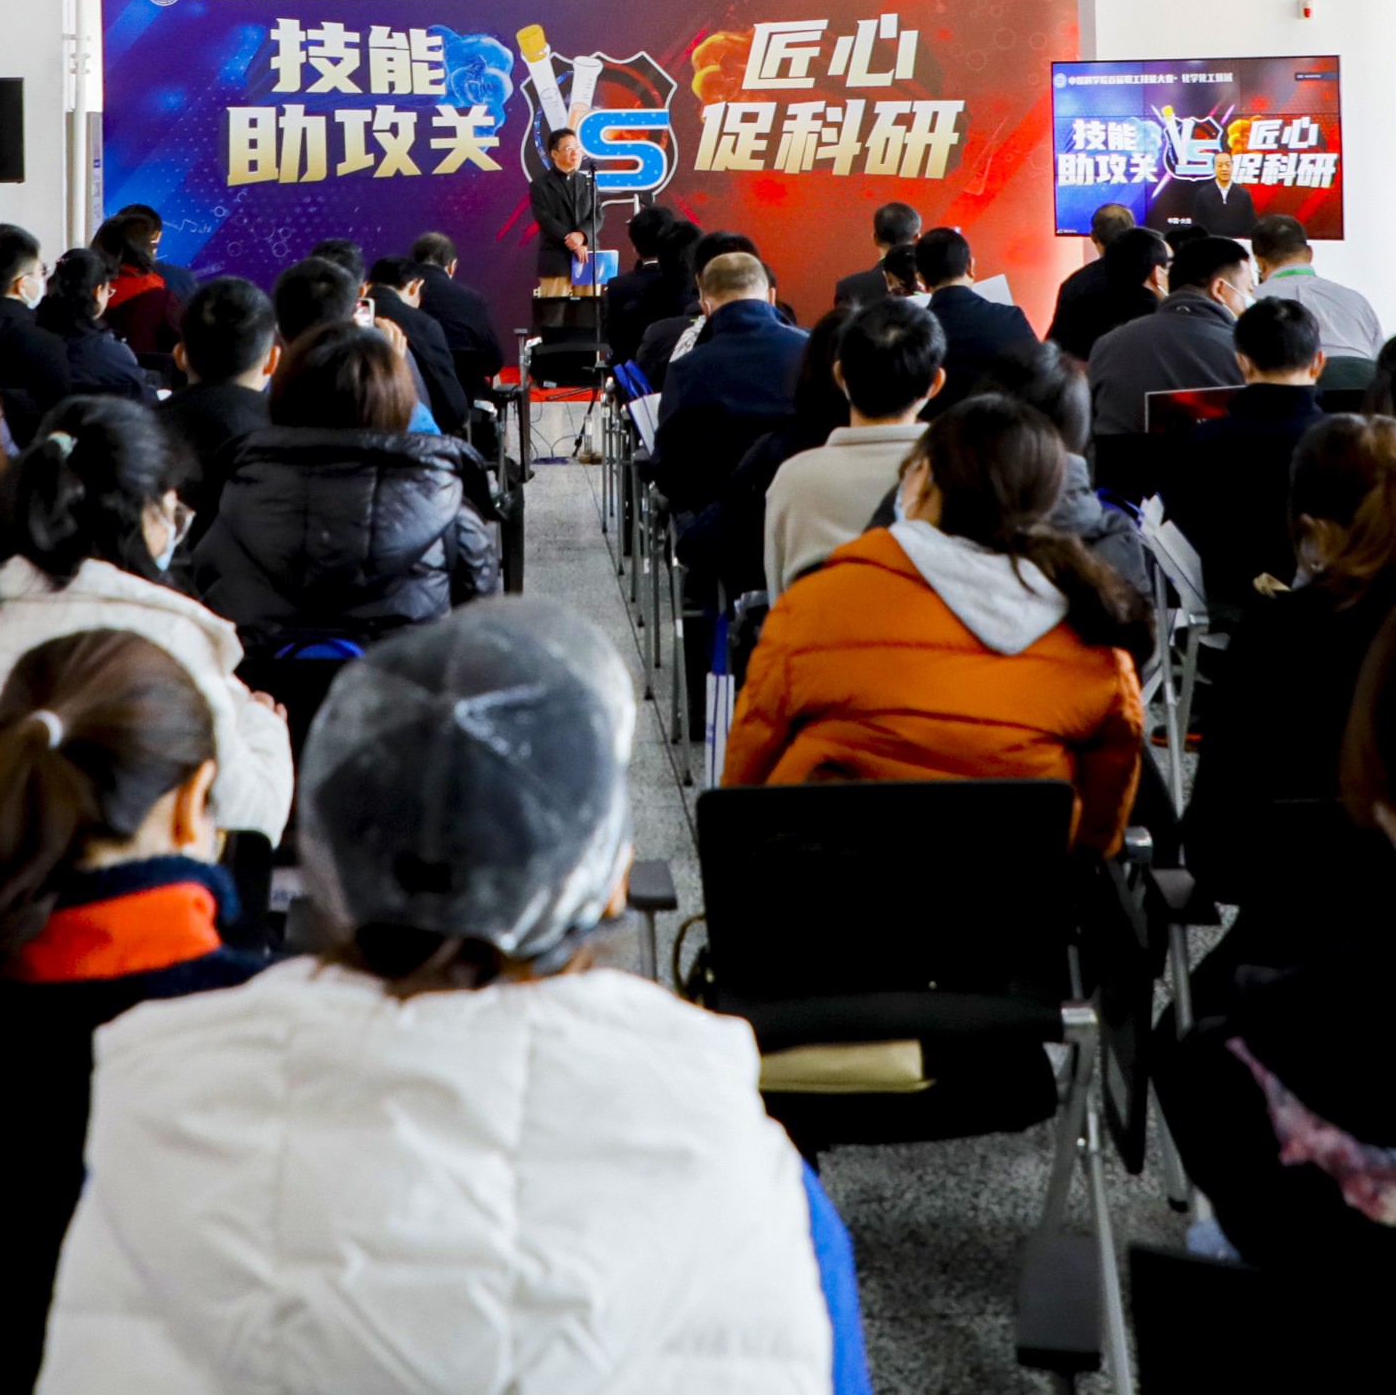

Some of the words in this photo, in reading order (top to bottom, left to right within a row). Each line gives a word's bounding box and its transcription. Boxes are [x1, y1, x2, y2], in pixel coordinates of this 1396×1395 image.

[270, 17, 446, 95] 技能
[741, 13, 919, 90] 匠心
[226, 104, 503, 186] 助攻关
[694, 99, 966, 179] 促科研
[1072, 118, 1138, 151] 技能
[1247, 116, 1320, 150] 匠心
[1057, 153, 1158, 186] 助攻关
[1232, 153, 1339, 188] 促科研
